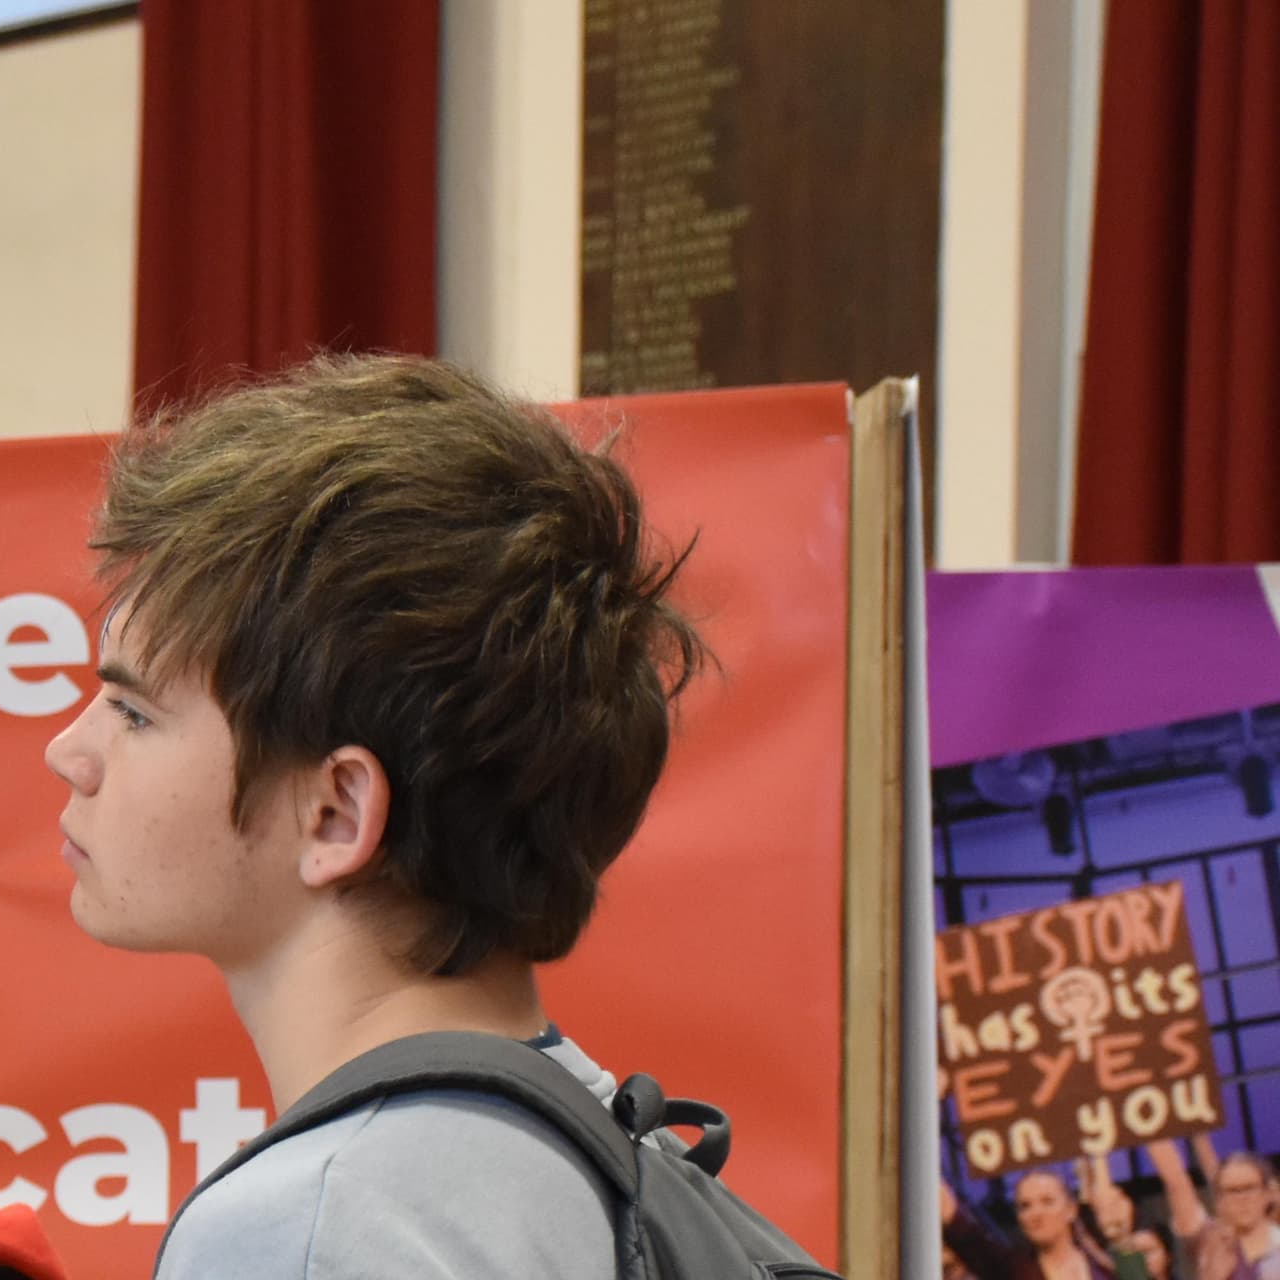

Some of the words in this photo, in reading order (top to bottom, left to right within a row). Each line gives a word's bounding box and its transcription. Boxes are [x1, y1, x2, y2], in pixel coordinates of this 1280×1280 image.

[937, 882, 1184, 998] HISTORY
[942, 1003, 1040, 1061] has
[1112, 963, 1201, 1020] its
[953, 1019, 1202, 1122] EYES
[966, 1118, 1051, 1172] on
[1076, 1076, 1217, 1156] you
